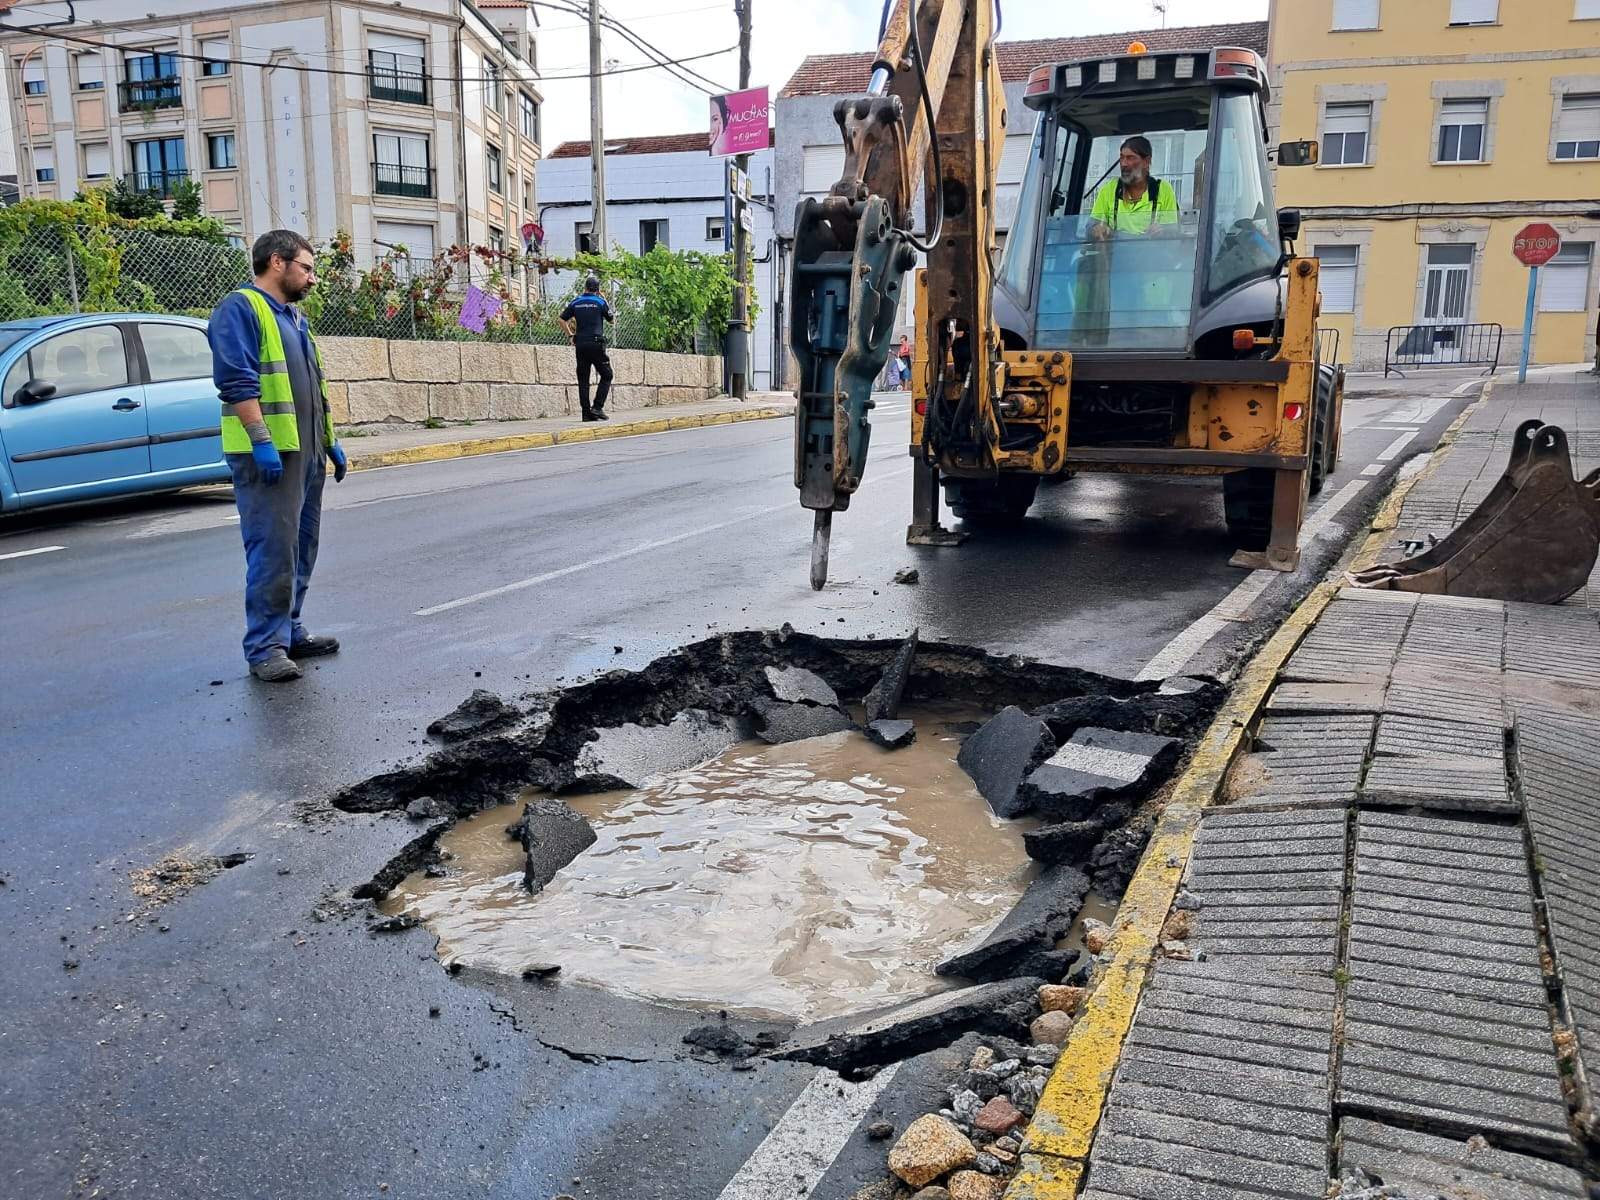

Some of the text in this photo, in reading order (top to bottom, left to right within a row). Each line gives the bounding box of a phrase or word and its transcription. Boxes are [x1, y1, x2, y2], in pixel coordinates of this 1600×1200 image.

[729, 104, 768, 122] MUCHAS
[283, 96, 297, 224] EDF 2000
[1514, 238, 1558, 250] STOP
